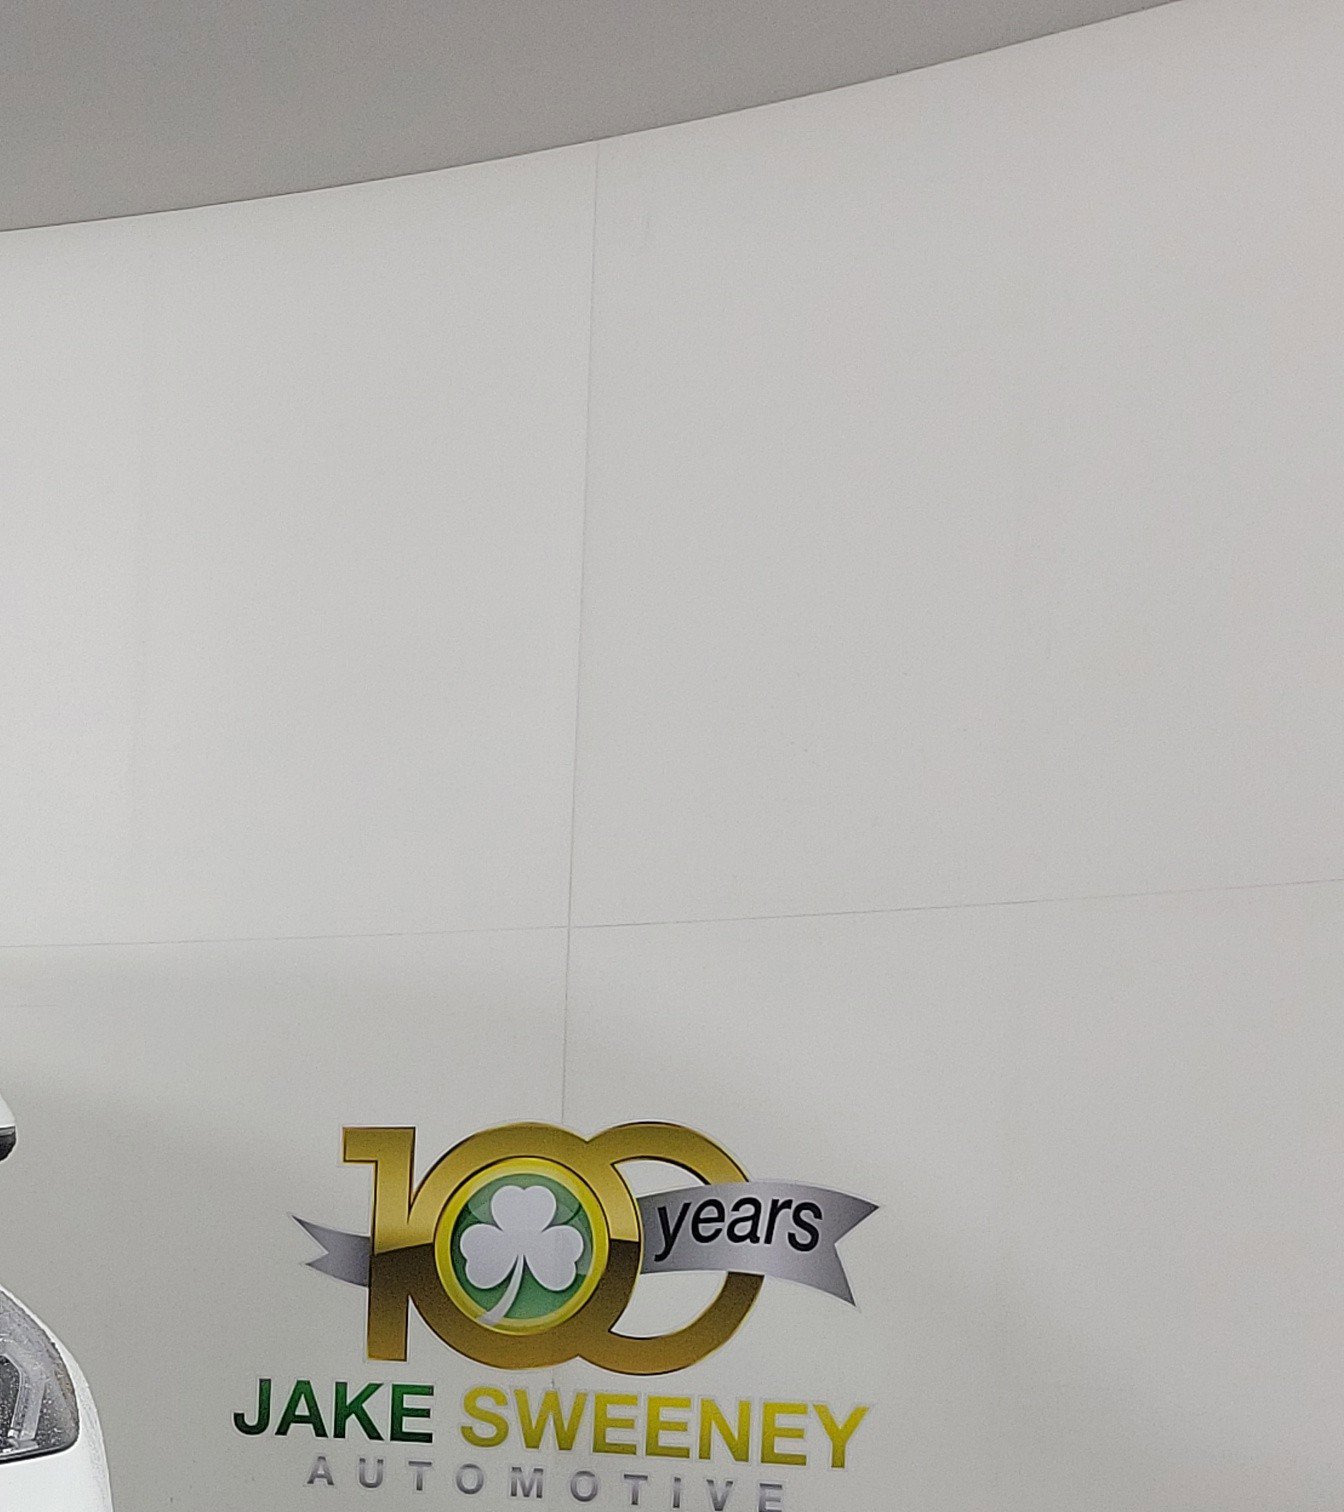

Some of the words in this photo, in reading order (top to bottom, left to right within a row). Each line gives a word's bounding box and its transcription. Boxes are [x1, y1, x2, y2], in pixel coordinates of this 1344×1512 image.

[342, 1121, 764, 1376] 100
[654, 1197, 823, 1262] years
[233, 1378, 434, 1443] JAKE
[460, 1386, 869, 1468] SWEENEY
